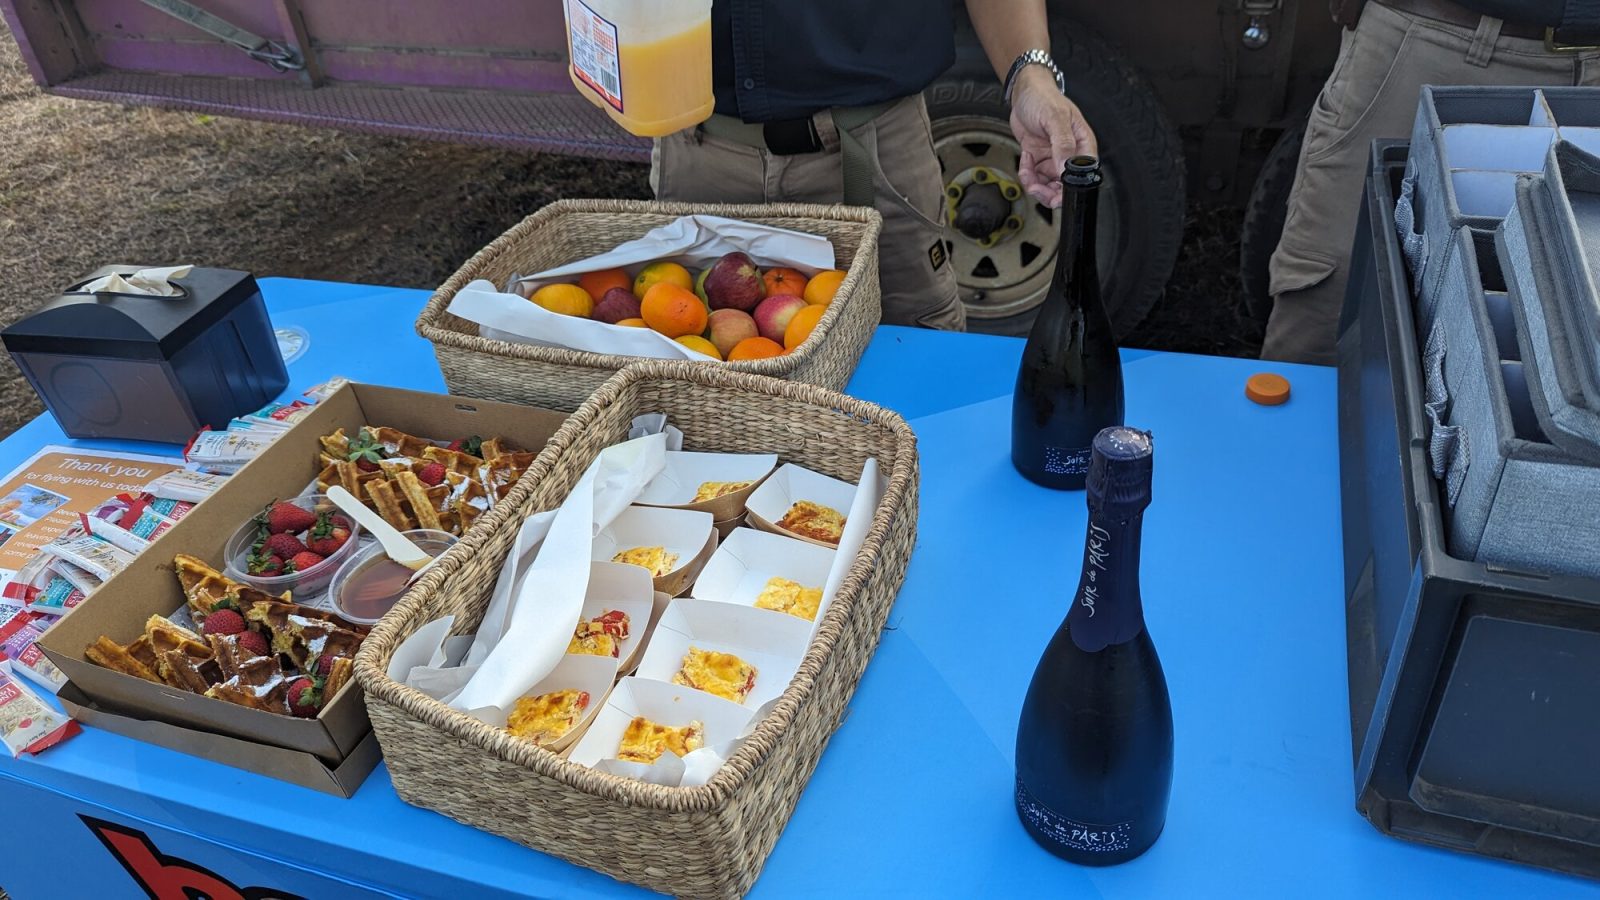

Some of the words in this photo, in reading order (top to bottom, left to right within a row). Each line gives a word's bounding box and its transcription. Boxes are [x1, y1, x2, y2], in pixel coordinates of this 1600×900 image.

[58, 458, 113, 473] Thank
[110, 466, 153, 479] you
[24, 471, 42, 481] for
[40, 472, 73, 485] flying
[73, 476, 99, 488] with
[99, 480, 116, 489] us
[115, 483, 144, 494] toda
[1086, 570, 1097, 582] de
[1055, 822, 1067, 832] de
